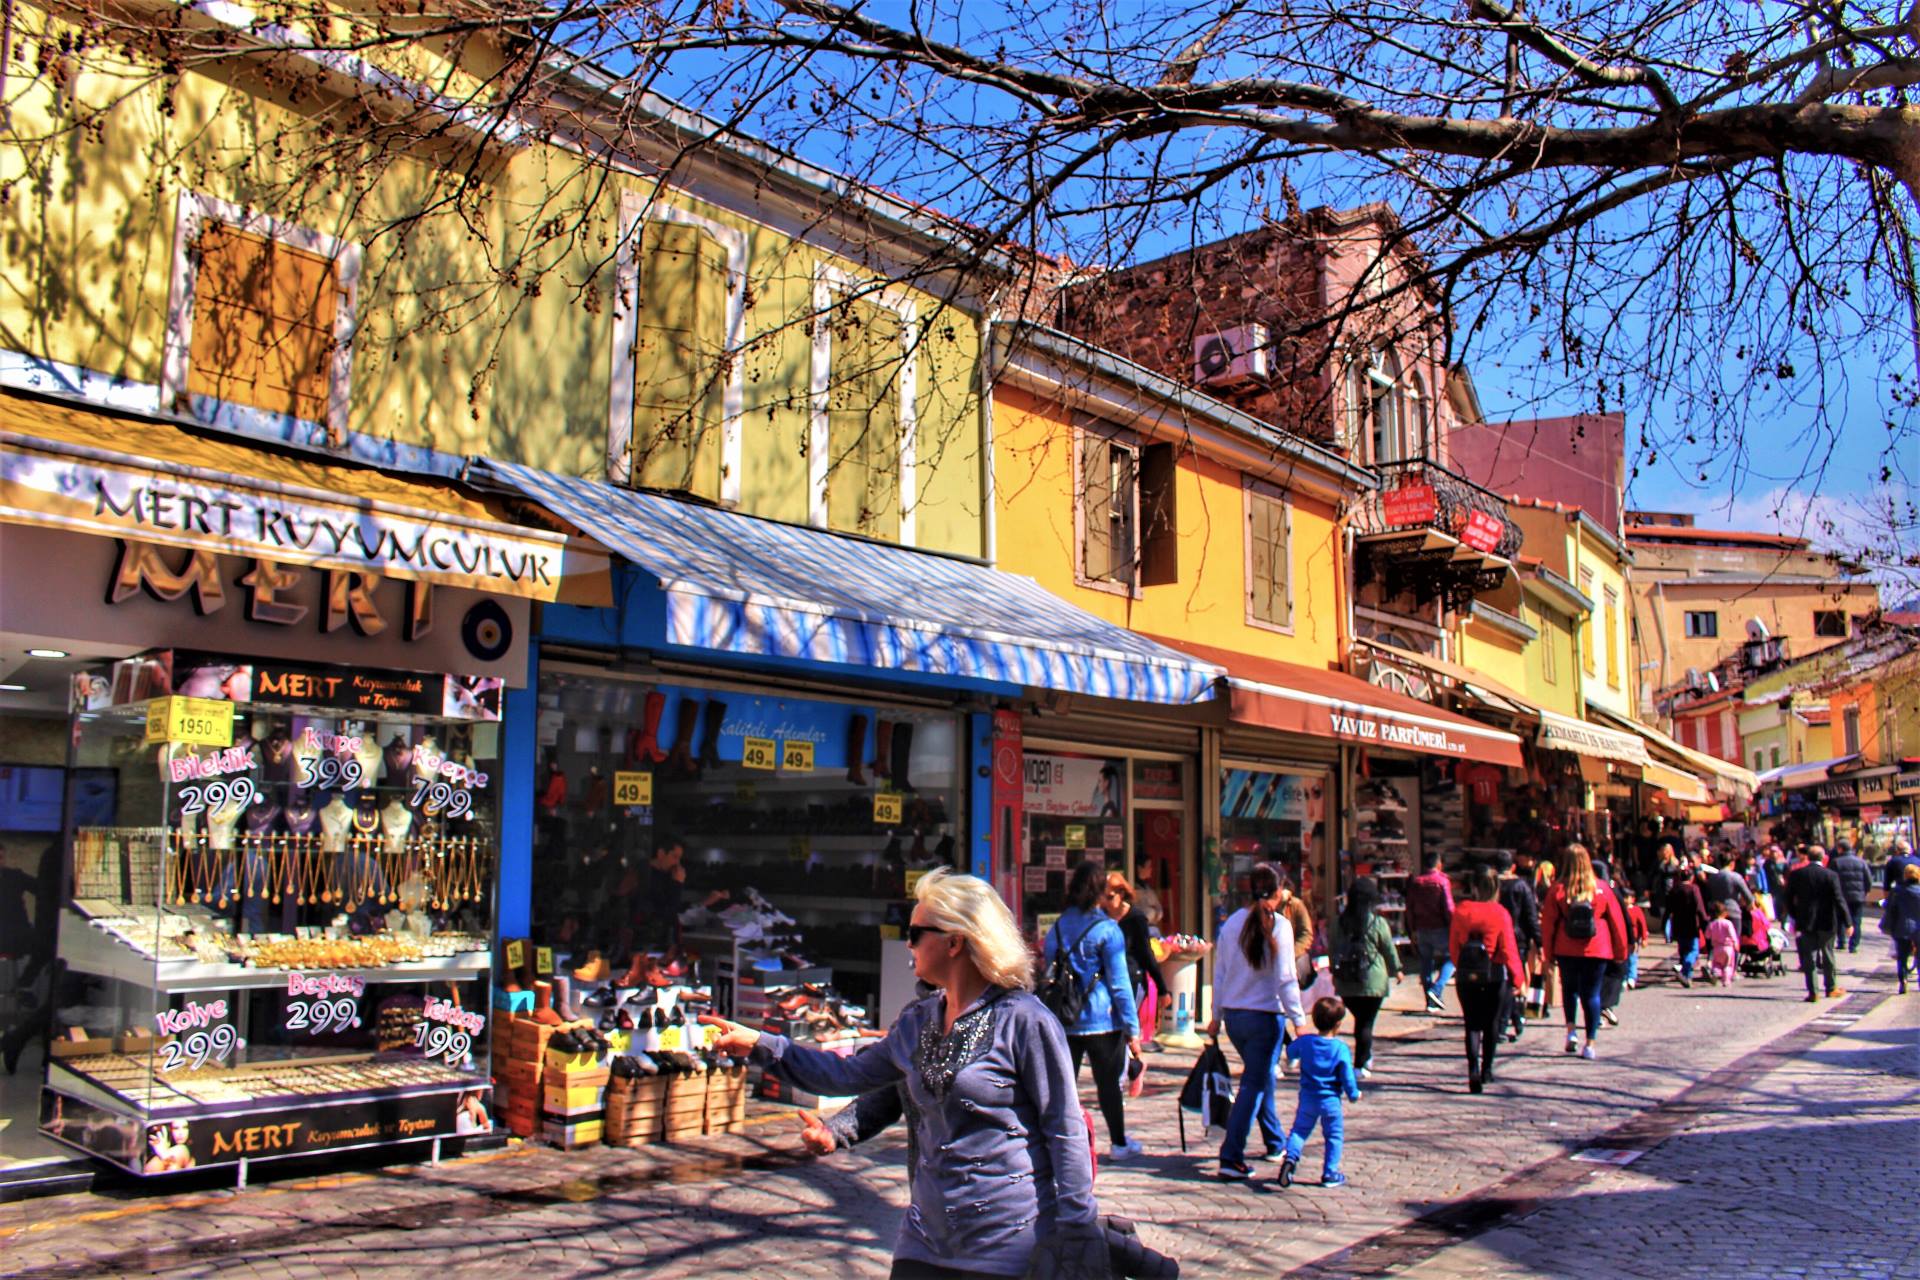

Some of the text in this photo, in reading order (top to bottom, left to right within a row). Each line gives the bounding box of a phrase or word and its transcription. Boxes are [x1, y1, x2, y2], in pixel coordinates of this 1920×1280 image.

[95, 481, 552, 585] MERT KUYUMCULUK
[259, 671, 343, 698] MERT
[180, 718, 213, 735] 1950
[1330, 714, 1376, 738] YAVUZ
[1380, 724, 1447, 750] PARFÜMERİ
[303, 727, 362, 754] Küpe
[169, 745, 257, 783] Bileklik
[412, 744, 489, 790] Kelepçe
[746, 749, 765, 766] 49
[785, 751, 804, 767] 49
[618, 783, 639, 801] 49
[876, 804, 893, 820] 49
[287, 972, 365, 999] Beştaş
[155, 1000, 229, 1037] Kolye
[423, 994, 485, 1036] Tektaş
[212, 1122, 302, 1155] MERT
[307, 1122, 381, 1146] Kuyumculuk
